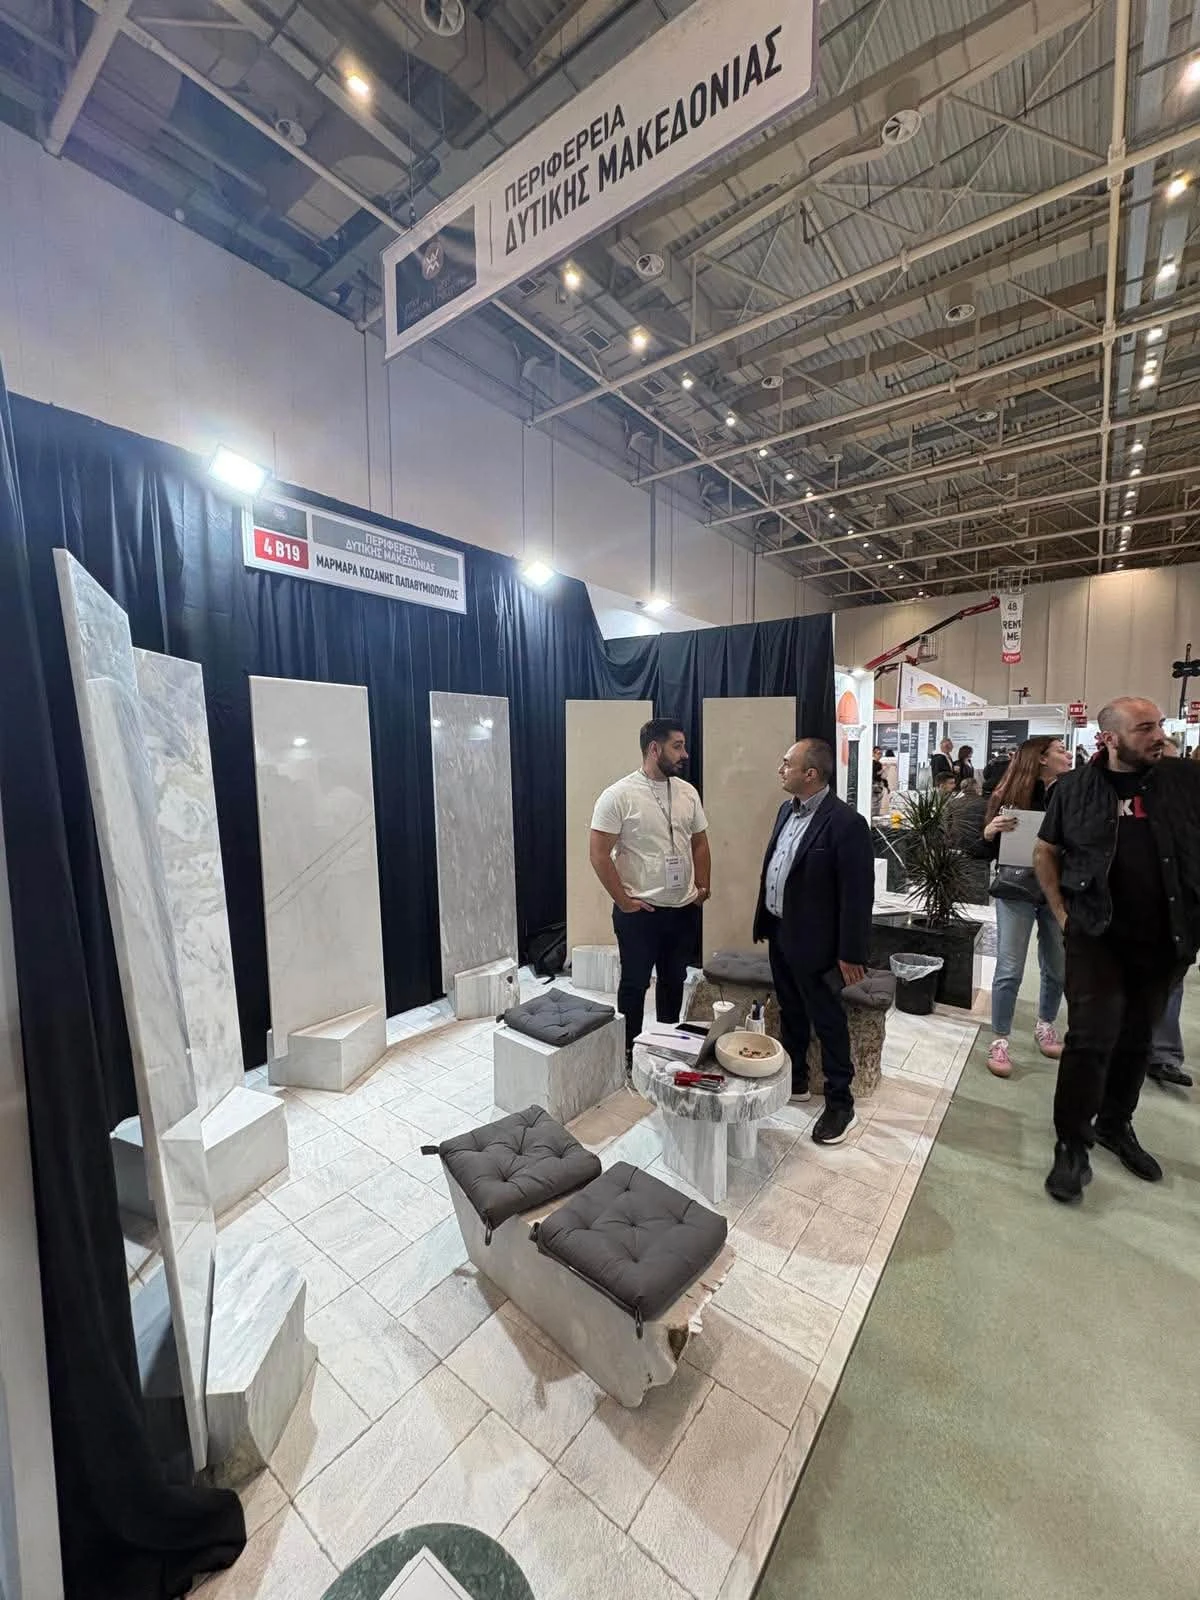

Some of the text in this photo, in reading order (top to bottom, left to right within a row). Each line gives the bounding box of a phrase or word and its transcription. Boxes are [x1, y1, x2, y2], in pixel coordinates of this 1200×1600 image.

[505, 25, 783, 256] ΔΥΤΙΚΗΣ ΜΑΚΕΔΟΝΙΑΣ
[505, 104, 625, 212] ΠΕΡΙΦΕΡΕΙΑ
[345, 540, 437, 573] ΔΥΤΙΚΗΣ ΜΑΚΕΔΟΝΙΑΣ
[365, 533, 418, 558] ΠΕΡΙΦΕΡΕΙΑ
[316, 553, 358, 577] ΜΑΡΜΑΡΑ
[360, 567, 394, 585] ΚΟΖΑΝΗΣ
[1003, 620, 1021, 630] RENT
[1007, 632, 1020, 641] ME
